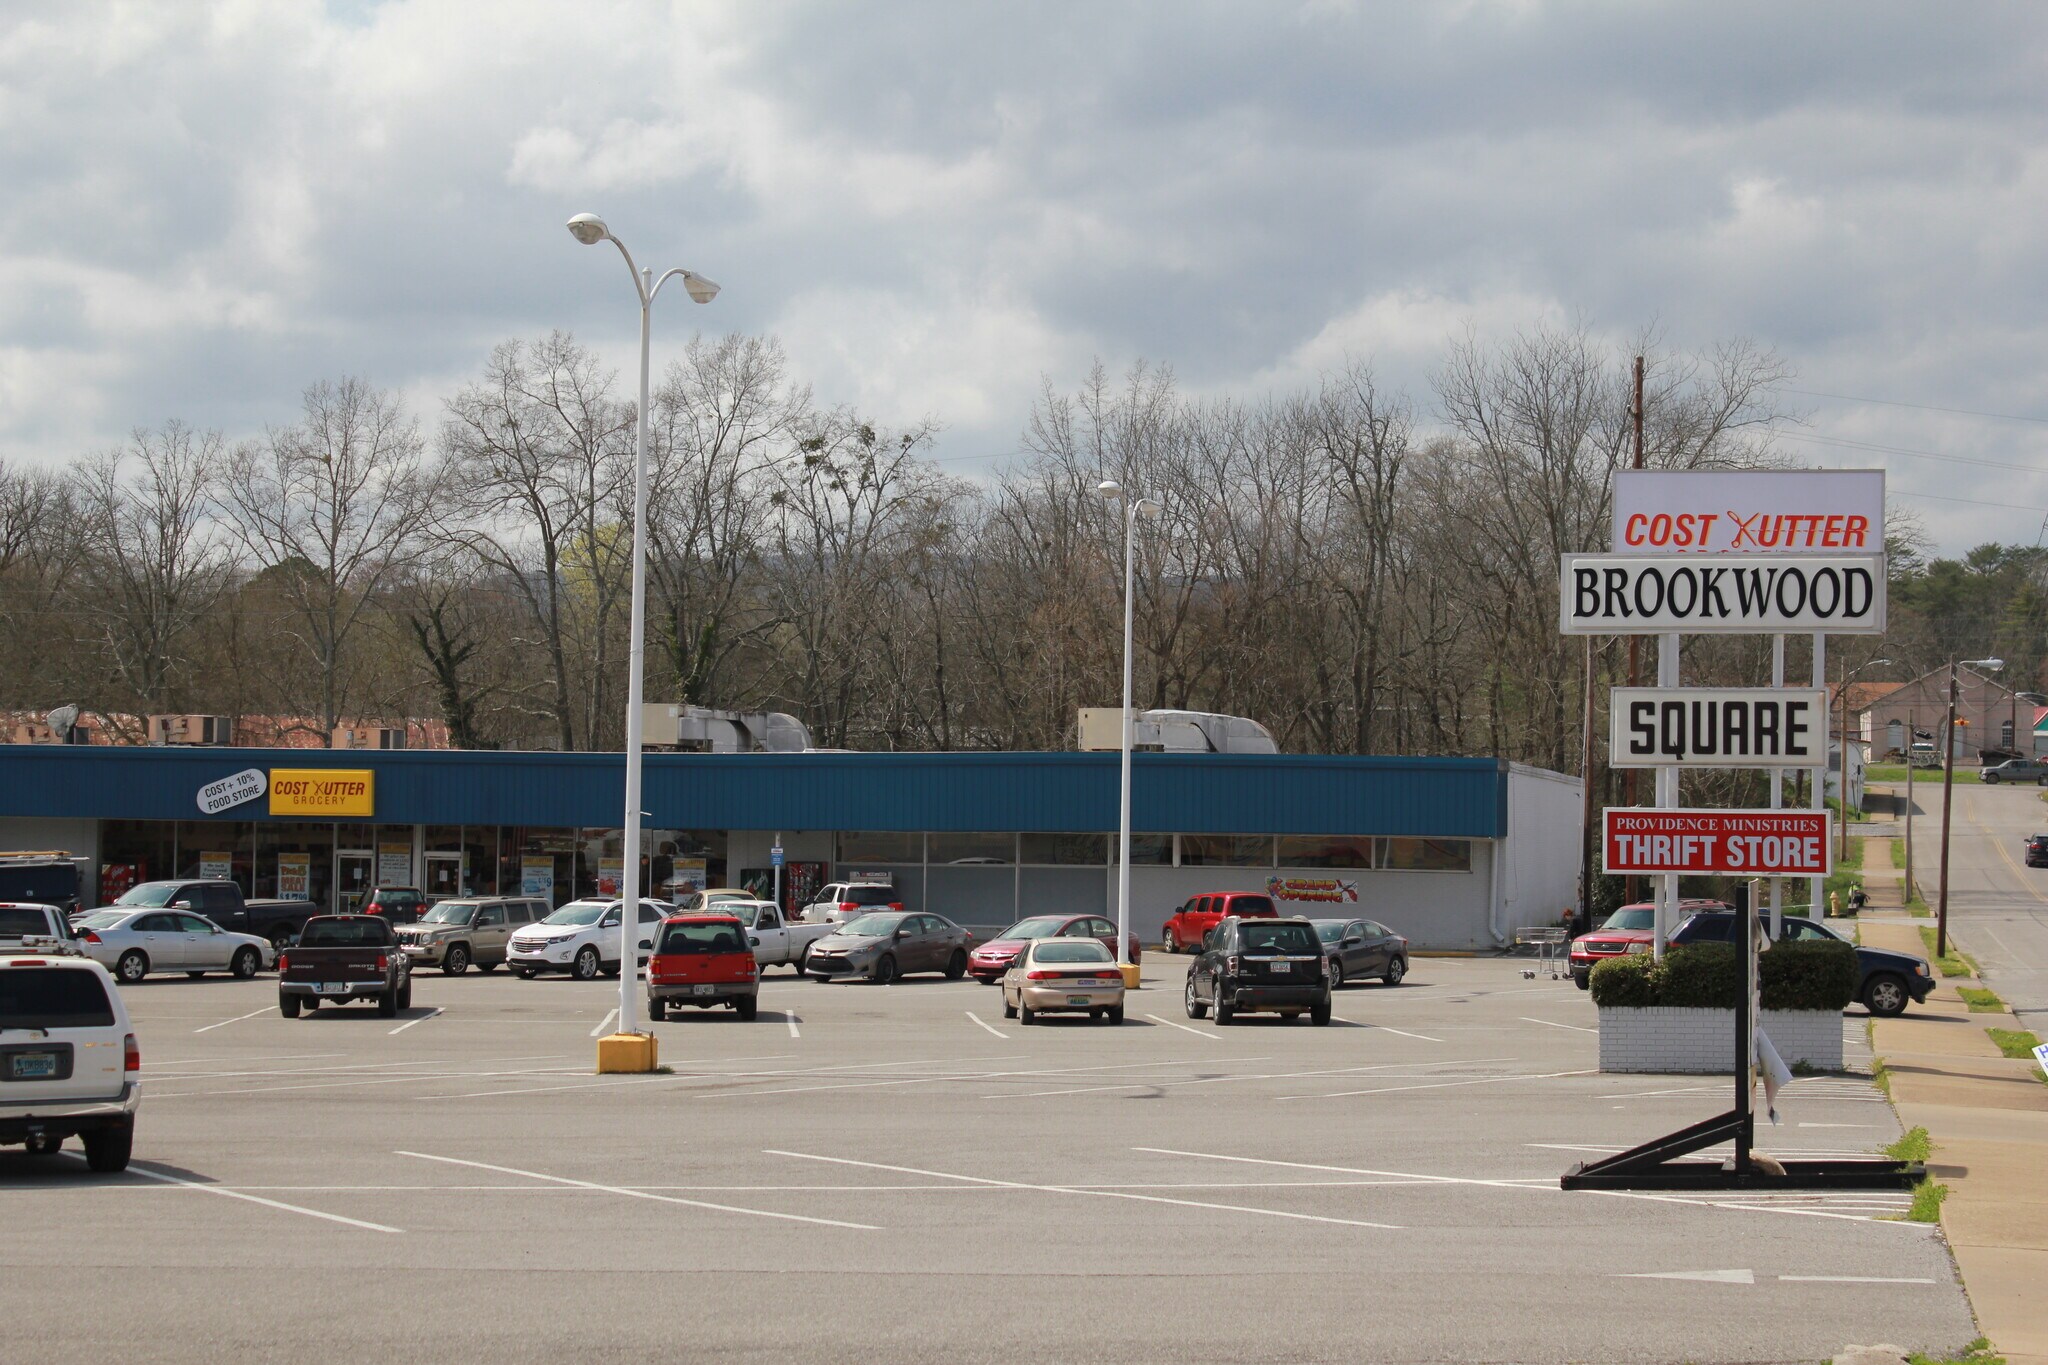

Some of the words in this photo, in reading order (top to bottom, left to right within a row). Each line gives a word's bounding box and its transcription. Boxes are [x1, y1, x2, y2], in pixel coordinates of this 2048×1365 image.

[1625, 513, 1717, 547] COST
[1573, 567, 1873, 619] BROOKWOOD
[1630, 701, 1808, 760] SQUARE
[236, 773, 256, 786] 10%
[274, 781, 309, 795] COST
[207, 795, 231, 811] FOOD
[232, 784, 260, 802] STORE
[293, 796, 346, 805] GROCERY
[1616, 818, 1718, 831] PROVIDENCE
[1722, 819, 1819, 832] MINISTRIES
[1615, 834, 1717, 865] THRIFT
[1727, 835, 1820, 867] STORE
[1286, 879, 1337, 891] GRAND
[1280, 889, 1343, 903] OPENING
